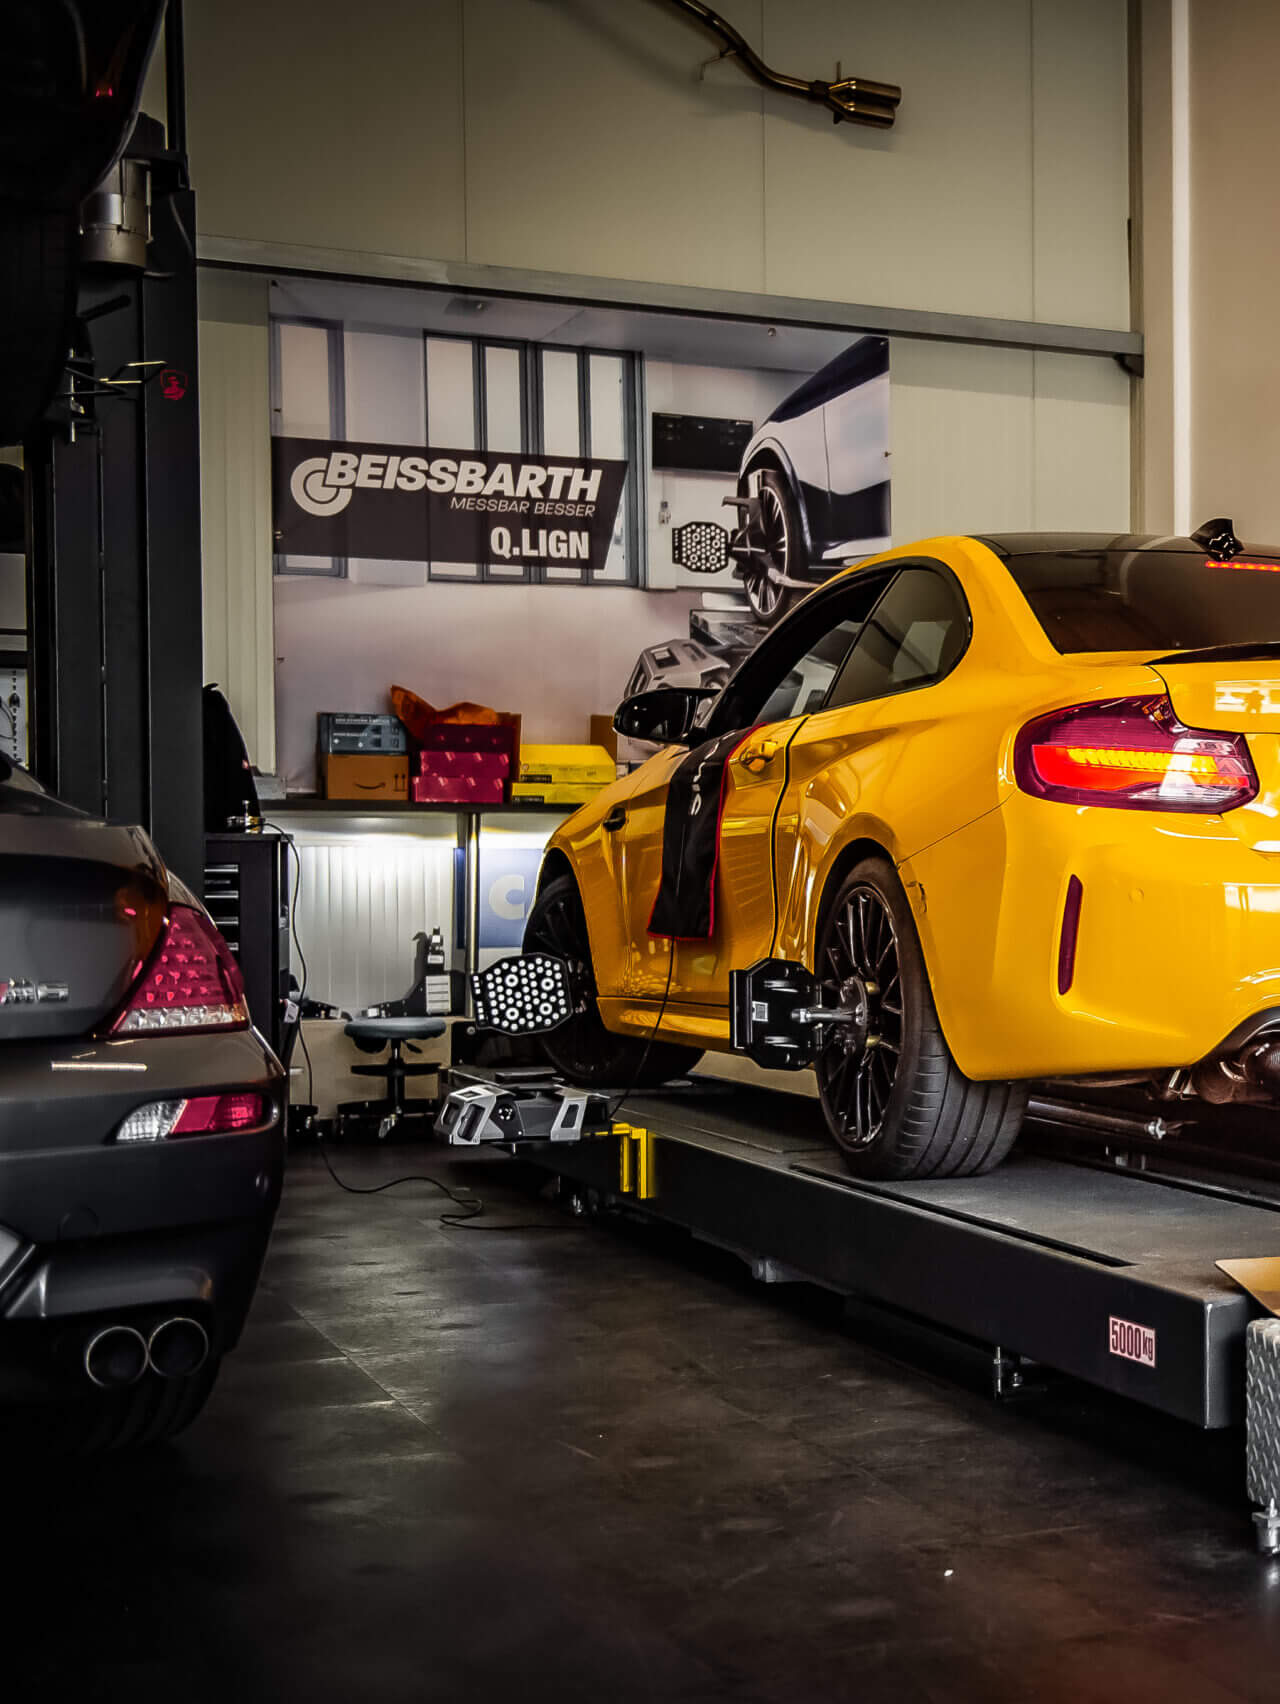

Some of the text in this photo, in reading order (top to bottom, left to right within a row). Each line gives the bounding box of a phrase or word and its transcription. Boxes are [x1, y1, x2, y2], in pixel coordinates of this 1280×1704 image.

[325, 452, 602, 502] BEISSBARTH
[450, 496, 596, 518] MESSBAR BESSER
[490, 526, 589, 560] Q.LIGN
